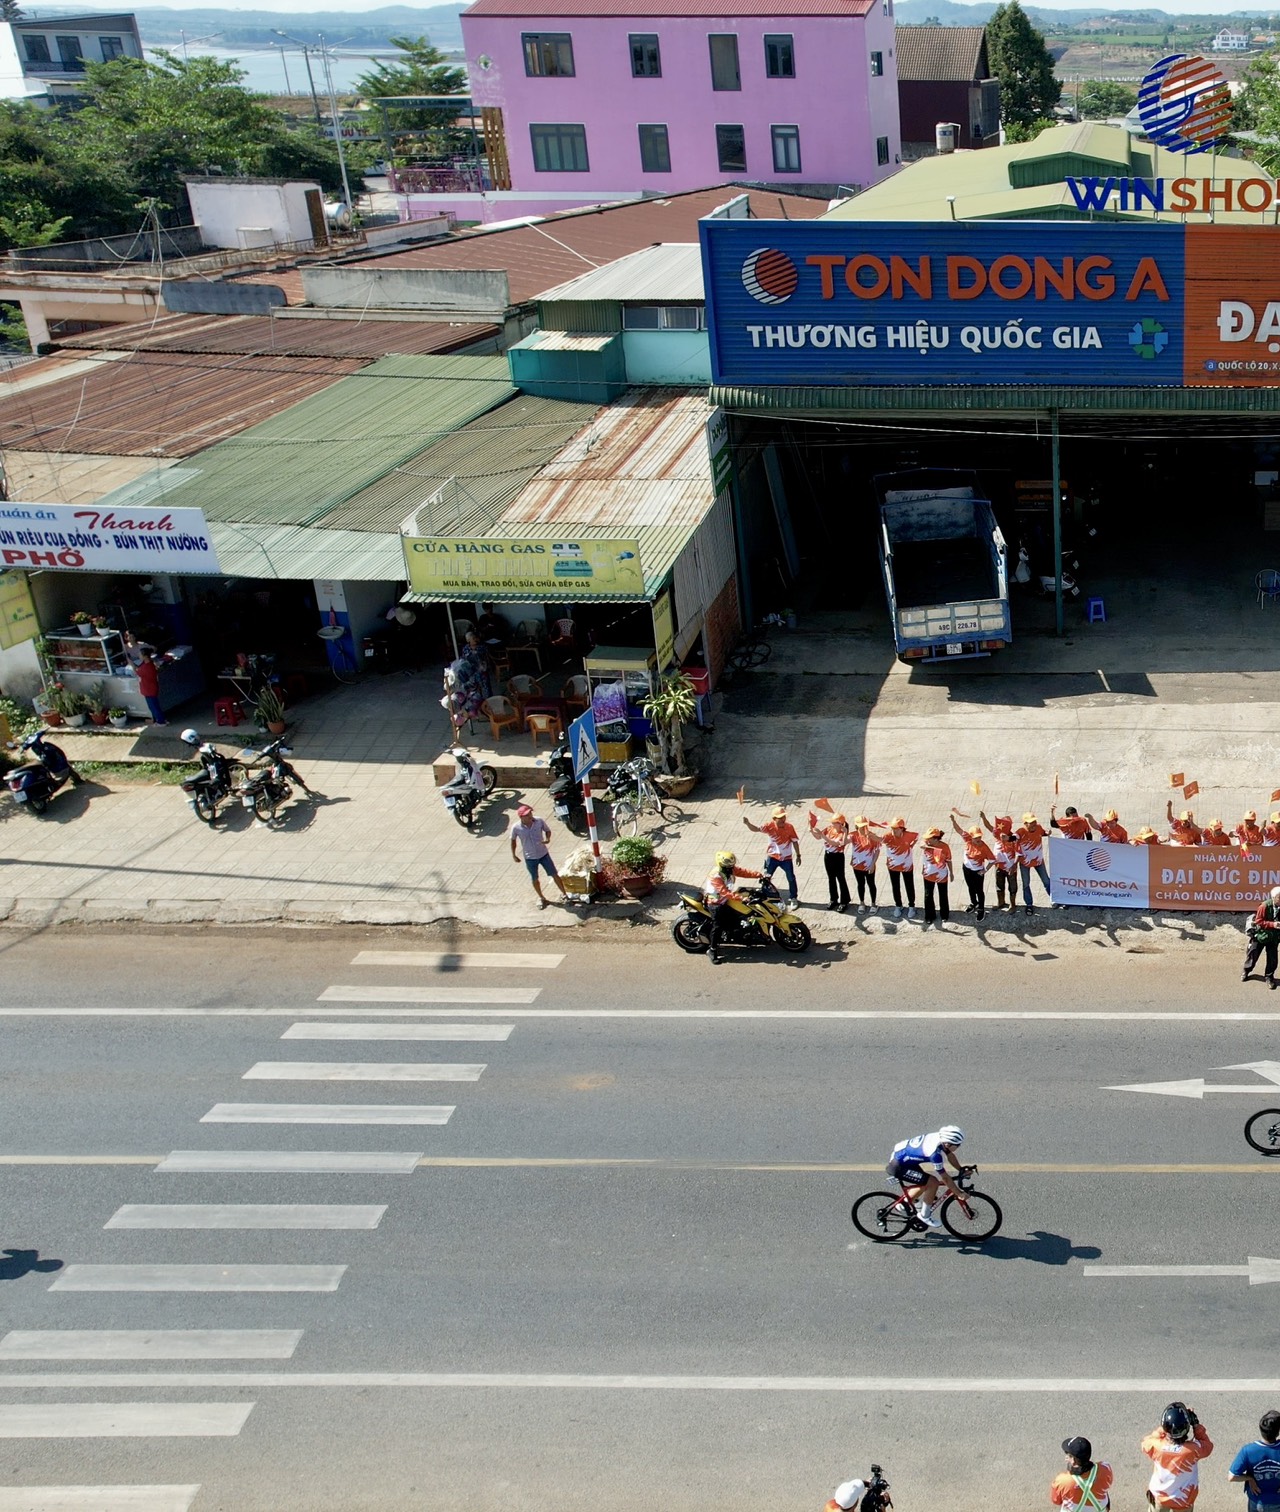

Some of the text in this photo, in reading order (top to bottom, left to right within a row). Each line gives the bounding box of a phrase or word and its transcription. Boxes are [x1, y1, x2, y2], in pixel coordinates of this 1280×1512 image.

[805, 255, 1170, 301] TON DONG A
[747, 318, 1103, 355] THƯƠNG HIỆU QUỐC GIA
[1218, 360, 1244, 370] QUỐC
[1245, 359, 1257, 371] LỘ
[74, 511, 176, 532] Thanh
[44, 531, 68, 548] CUA
[113, 531, 139, 550] BÚN
[138, 535, 165, 553] THỊT
[413, 540, 546, 554] CỬA HÀNG GAS
[2, 546, 85, 567] PHỞ
[575, 580, 591, 588] GAS
[1194, 853, 1216, 862] NHÀ
[1218, 853, 1240, 862] MÁY
[1059, 877, 1139, 891] TON DONG A
[1161, 868, 1194, 888] ĐẠI
[1201, 865, 1241, 885] ĐỨC
[1155, 889, 1191, 901] CHÀO
[1193, 889, 1232, 901] MỪNG
[1235, 889, 1272, 901] ĐOÀN
